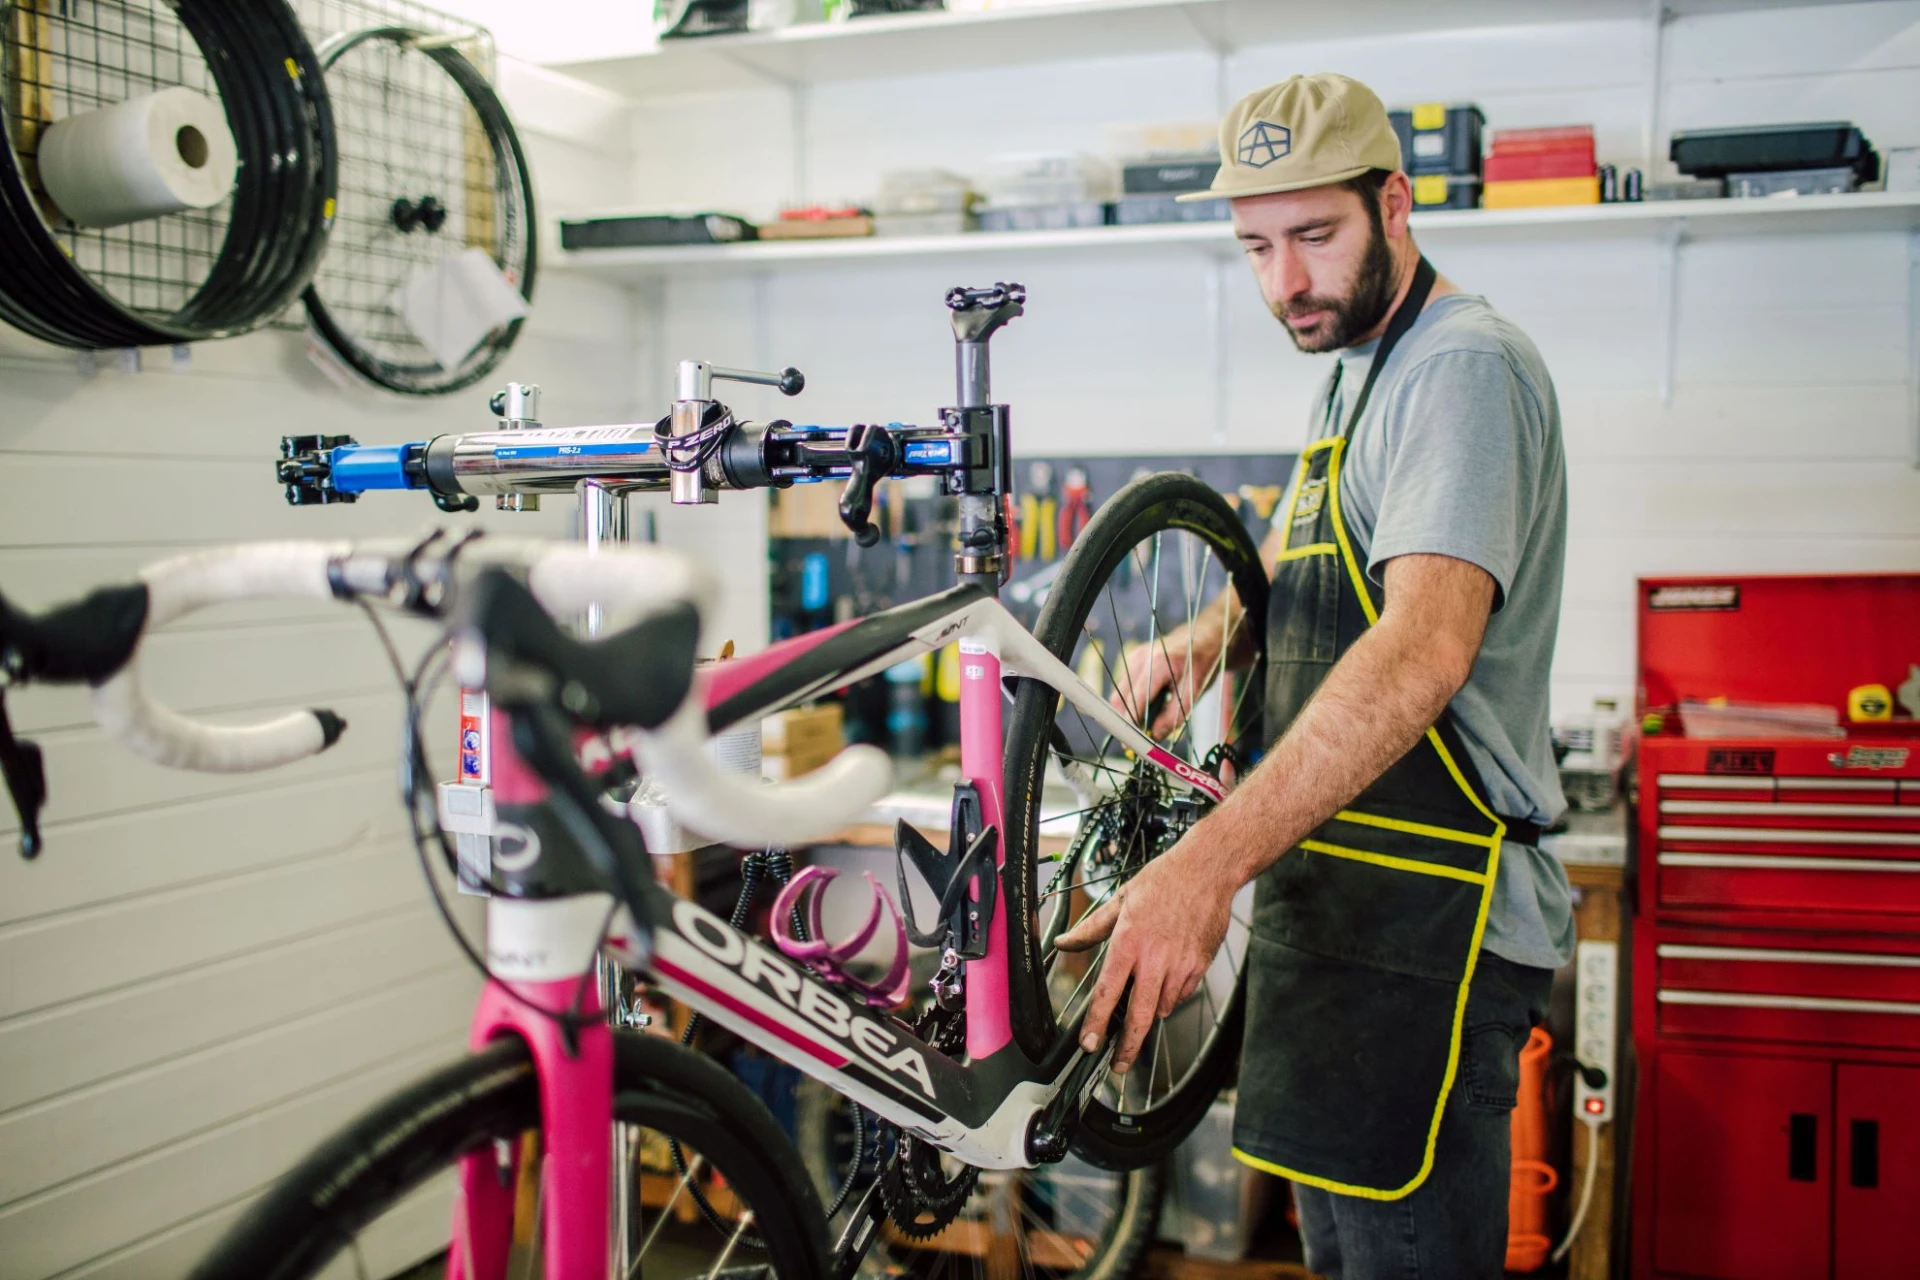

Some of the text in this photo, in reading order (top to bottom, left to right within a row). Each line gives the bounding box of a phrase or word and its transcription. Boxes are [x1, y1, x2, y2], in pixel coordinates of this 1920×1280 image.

[668, 416, 731, 449] P ZERO
[1175, 762, 1229, 797] ORBE
[1020, 852, 1028, 898] PRIX
[1021, 899, 1031, 957] GRAND
[672, 899, 937, 1099] ORBEA
